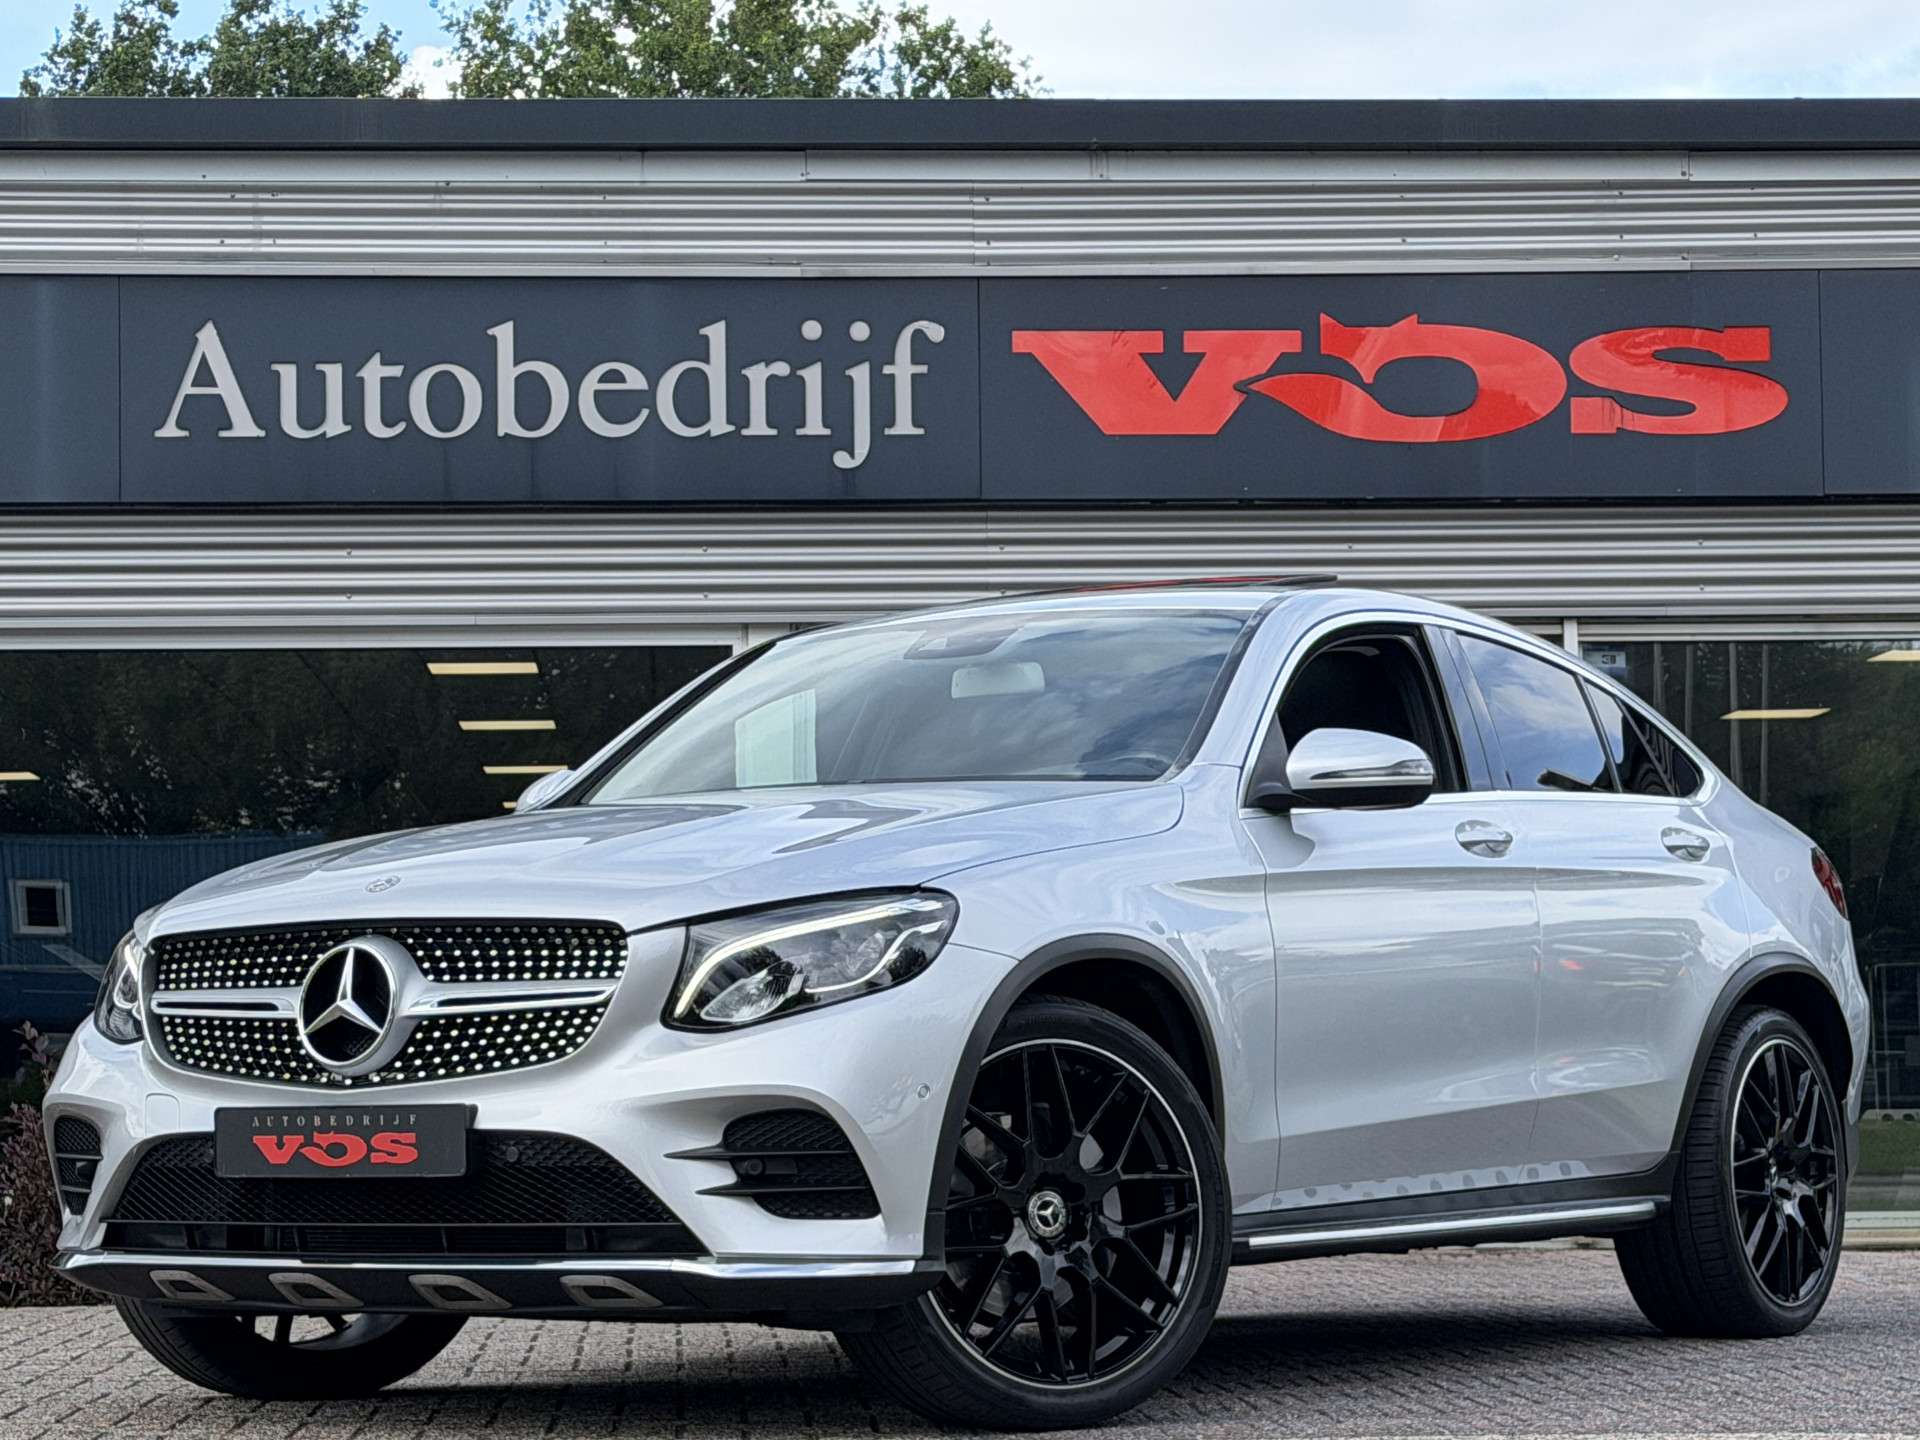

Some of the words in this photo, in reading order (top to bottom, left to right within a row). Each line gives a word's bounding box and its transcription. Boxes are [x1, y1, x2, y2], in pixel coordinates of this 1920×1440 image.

[154, 320, 946, 470] Autobedrijf
[1011, 313, 1790, 443] VOS
[251, 1114, 417, 1128] AUTOBEDRIJF
[252, 1131, 419, 1167] VOS
